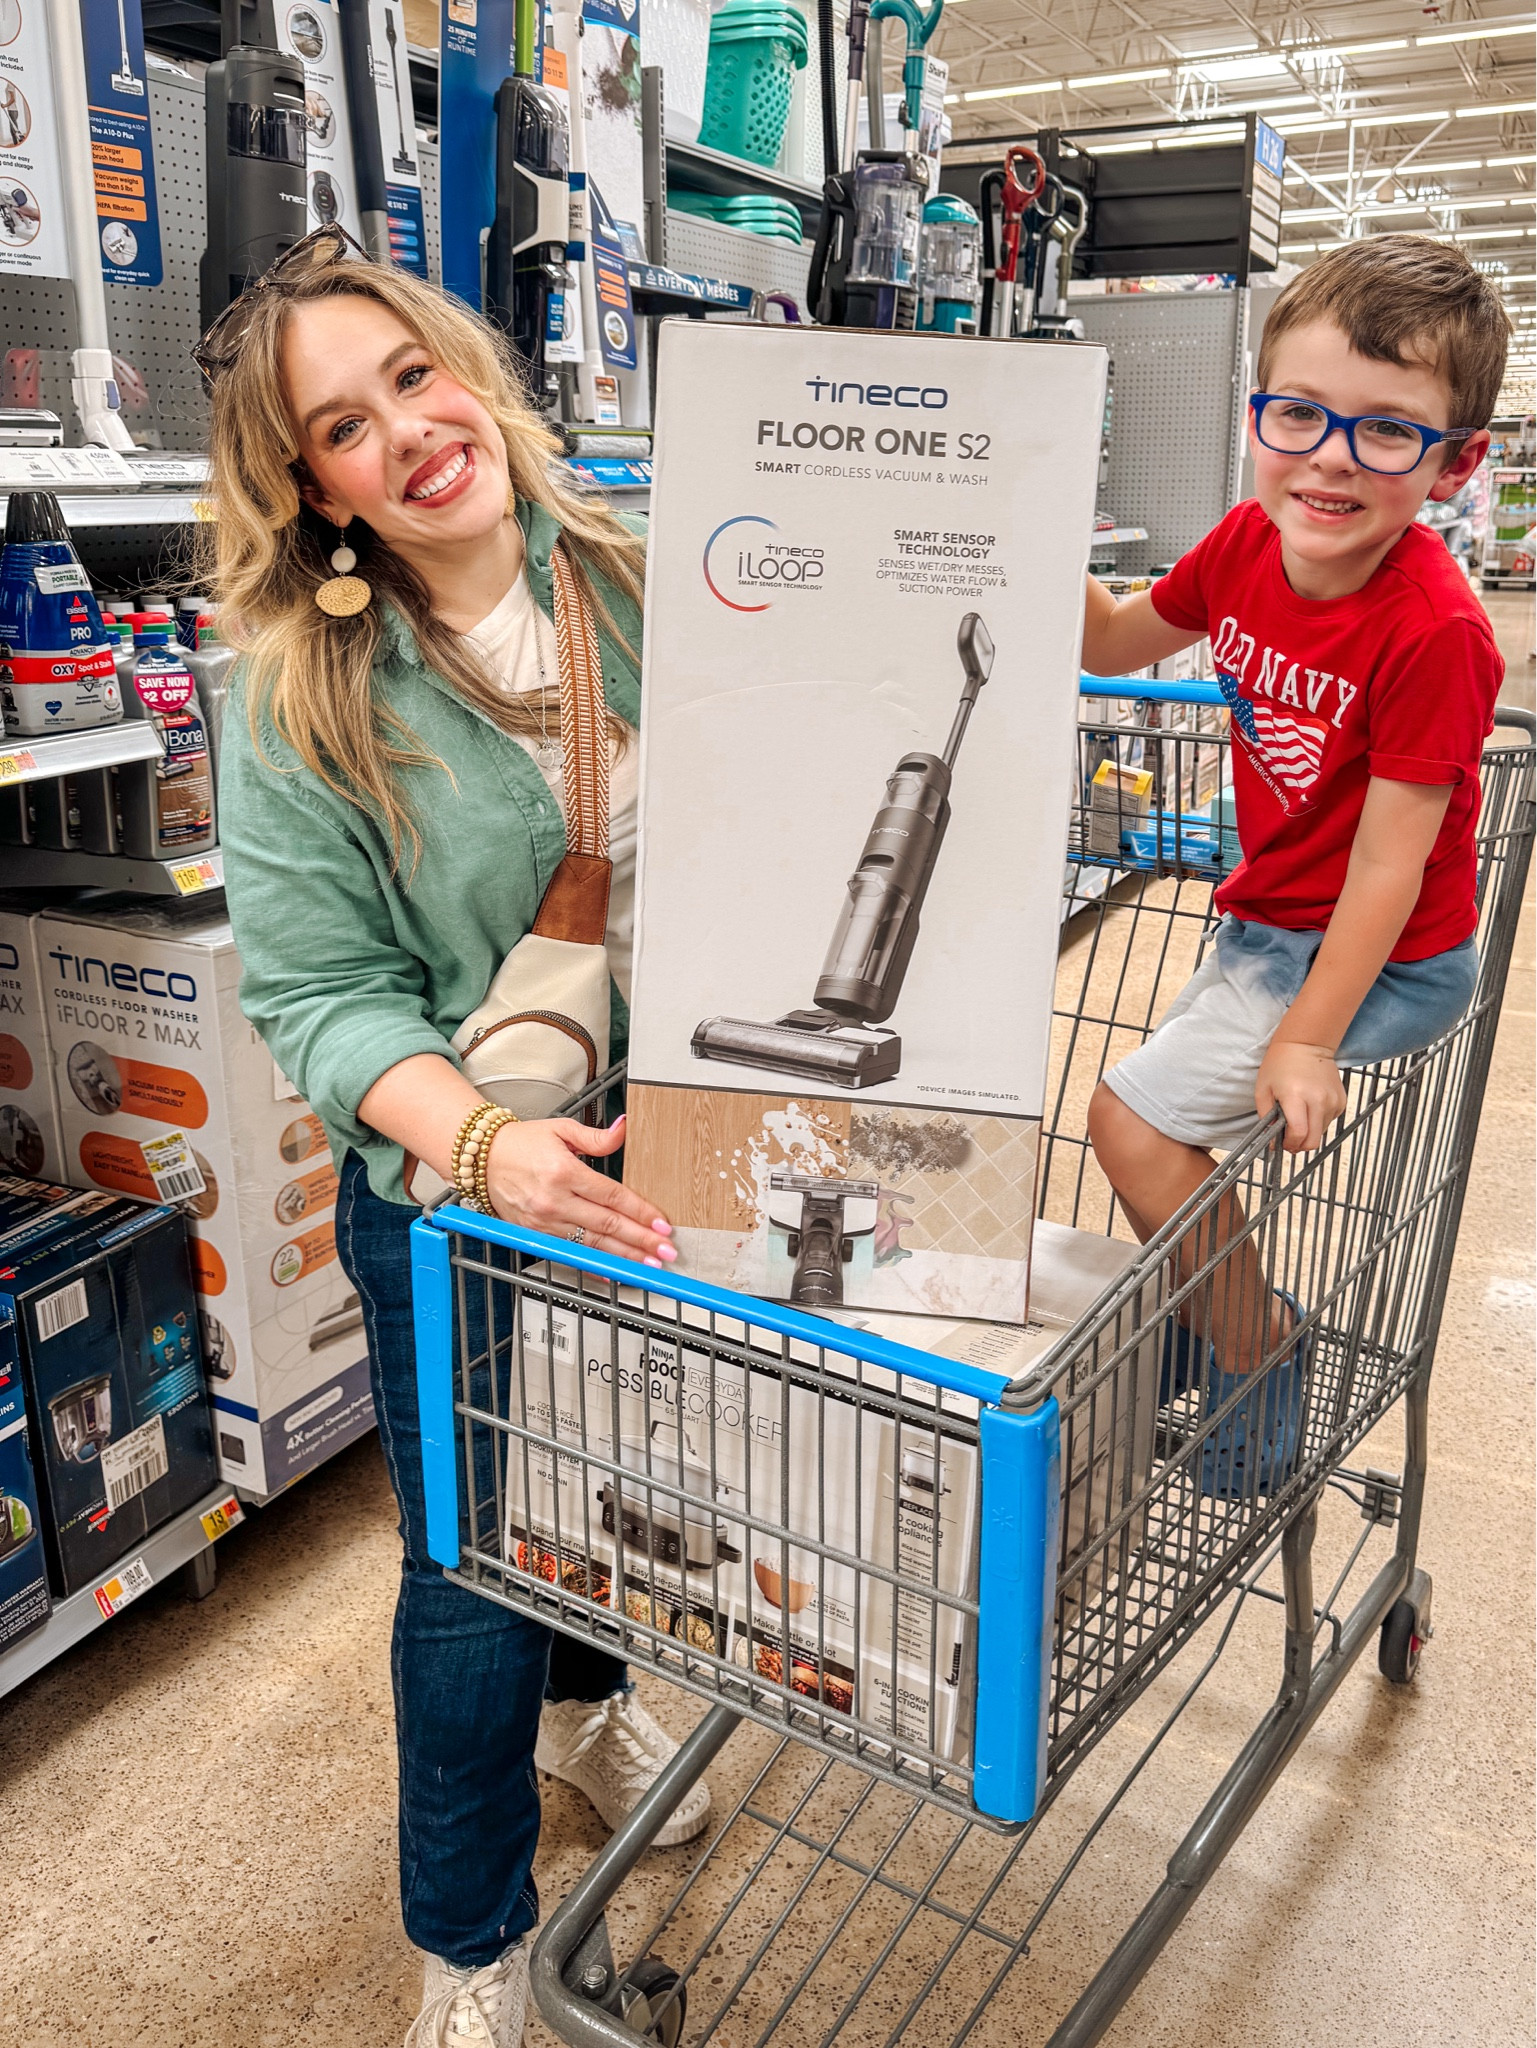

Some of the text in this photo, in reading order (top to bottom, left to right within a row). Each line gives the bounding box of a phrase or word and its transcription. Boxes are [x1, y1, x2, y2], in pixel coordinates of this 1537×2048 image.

[455, 26, 477, 39] MINUTES
[457, 36, 467, 44] OF
[447, 41, 477, 57] RUNTIME
[91, 125, 102, 134] The
[122, 132, 134, 140] Plus
[104, 147, 121, 155] larger
[109, 155, 124, 163] head
[94, 172, 139, 185] Vacuum weighs
[107, 181, 119, 190] than
[97, 201, 134, 212] HEPA filtration
[657, 273, 739, 302] EVERYDY MESSES
[805, 375, 948, 409] tineco
[757, 419, 991, 460] FLOOR ONE S2
[754, 461, 988, 486] SMART CORDLESS VACUUM & WASH
[893, 529, 996, 546] SMART SENSOR
[765, 543, 824, 558] tineco
[898, 543, 990, 559] TECHNOLOGY
[878, 558, 1007, 577] SENSES WET/DRY MESSES,
[52, 575, 78, 583] PORTABLE
[783, 582, 823, 590] TECHNOLOGY
[876, 569, 1007, 588] OPTIMIZES WATER FLOW &
[898, 583, 983, 597] SUCTION POWER
[70, 626, 91, 640] PRO
[70, 647, 96, 655] ADVANCED
[52, 663, 76, 676] OXY
[78, 663, 93, 672] Spot
[1212, 616, 1357, 729] OLD NAVY
[139, 676, 190, 689] SAVE NOW
[142, 689, 189, 702] $2 OFF
[168, 729, 203, 746] Bona
[1247, 754, 1276, 790] AMERICAN
[49, 945, 197, 1002] tineco
[54, 988, 199, 1023] CORDLESS FLOOR WASHER
[57, 1004, 202, 1050] iFLOOR 2 MAX
[128, 1079, 186, 1097] VACUUM AND MOP
[948, 1088, 976, 1097] IMAGES
[978, 1090, 1021, 1101] SIMULATED.
[129, 1089, 183, 1107] SIMULTANEOUSLY
[38, 1218, 60, 1230] THE
[90, 1205, 139, 1231] SPOTCLEAN
[50, 1226, 92, 1252] PROHEAT
[279, 1249, 294, 1265] 22
[651, 1345, 674, 1361] NINJA
[690, 1371, 749, 1399] EVERYDAY
[587, 1359, 783, 1441] POSSBLECOOKER
[560, 1410, 574, 1420] RICE
[286, 1407, 351, 1450] 4X Better Cleaning
[560, 1418, 582, 1429] FASTE
[288, 1416, 354, 1464] And Larger Brush Head
[528, 1441, 553, 1454] COOKIN
[537, 1469, 568, 1486] NO DAIN
[903, 1501, 933, 1518] REPLACE
[906, 1517, 943, 1539] cookig
[898, 1527, 942, 1548] ppliancs
[559, 1537, 571, 1546] our
[573, 1542, 594, 1555] meu
[913, 1546, 931, 1557] cooker
[913, 1559, 932, 1570] warmer
[631, 1565, 649, 1579] Easy
[653, 1575, 682, 1591] ne-pot
[921, 1573, 931, 1582] pot
[836, 1613, 850, 1621] PASTA
[910, 1605, 927, 1615] cooker
[901, 1613, 920, 1625] Saucier
[754, 1616, 775, 1632] Make
[805, 1639, 815, 1648] or
[825, 1646, 836, 1658] lot
[913, 1629, 923, 1638] pan
[910, 1652, 922, 1660] oven
[874, 1678, 929, 1707] 6-IN- COOKIN
[881, 1689, 927, 1713] FUCTIONS
[905, 1712, 925, 1724] COATING
